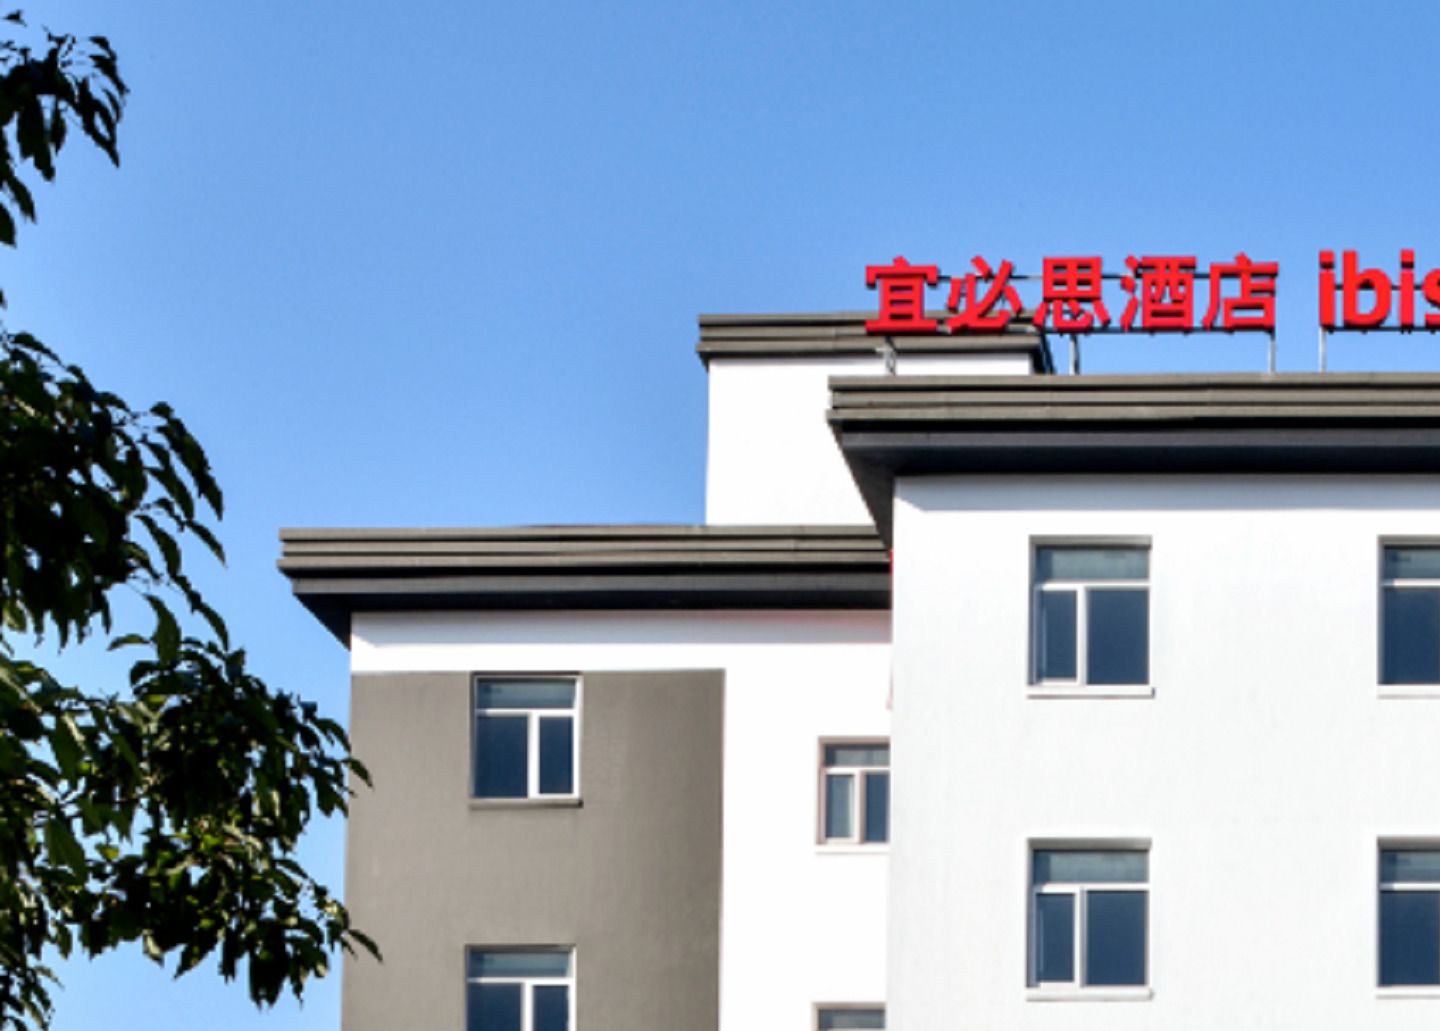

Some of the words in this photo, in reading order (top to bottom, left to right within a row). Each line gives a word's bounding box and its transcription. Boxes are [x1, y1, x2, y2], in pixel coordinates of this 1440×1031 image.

[864, 253, 1279, 332] 宜必思酒店
